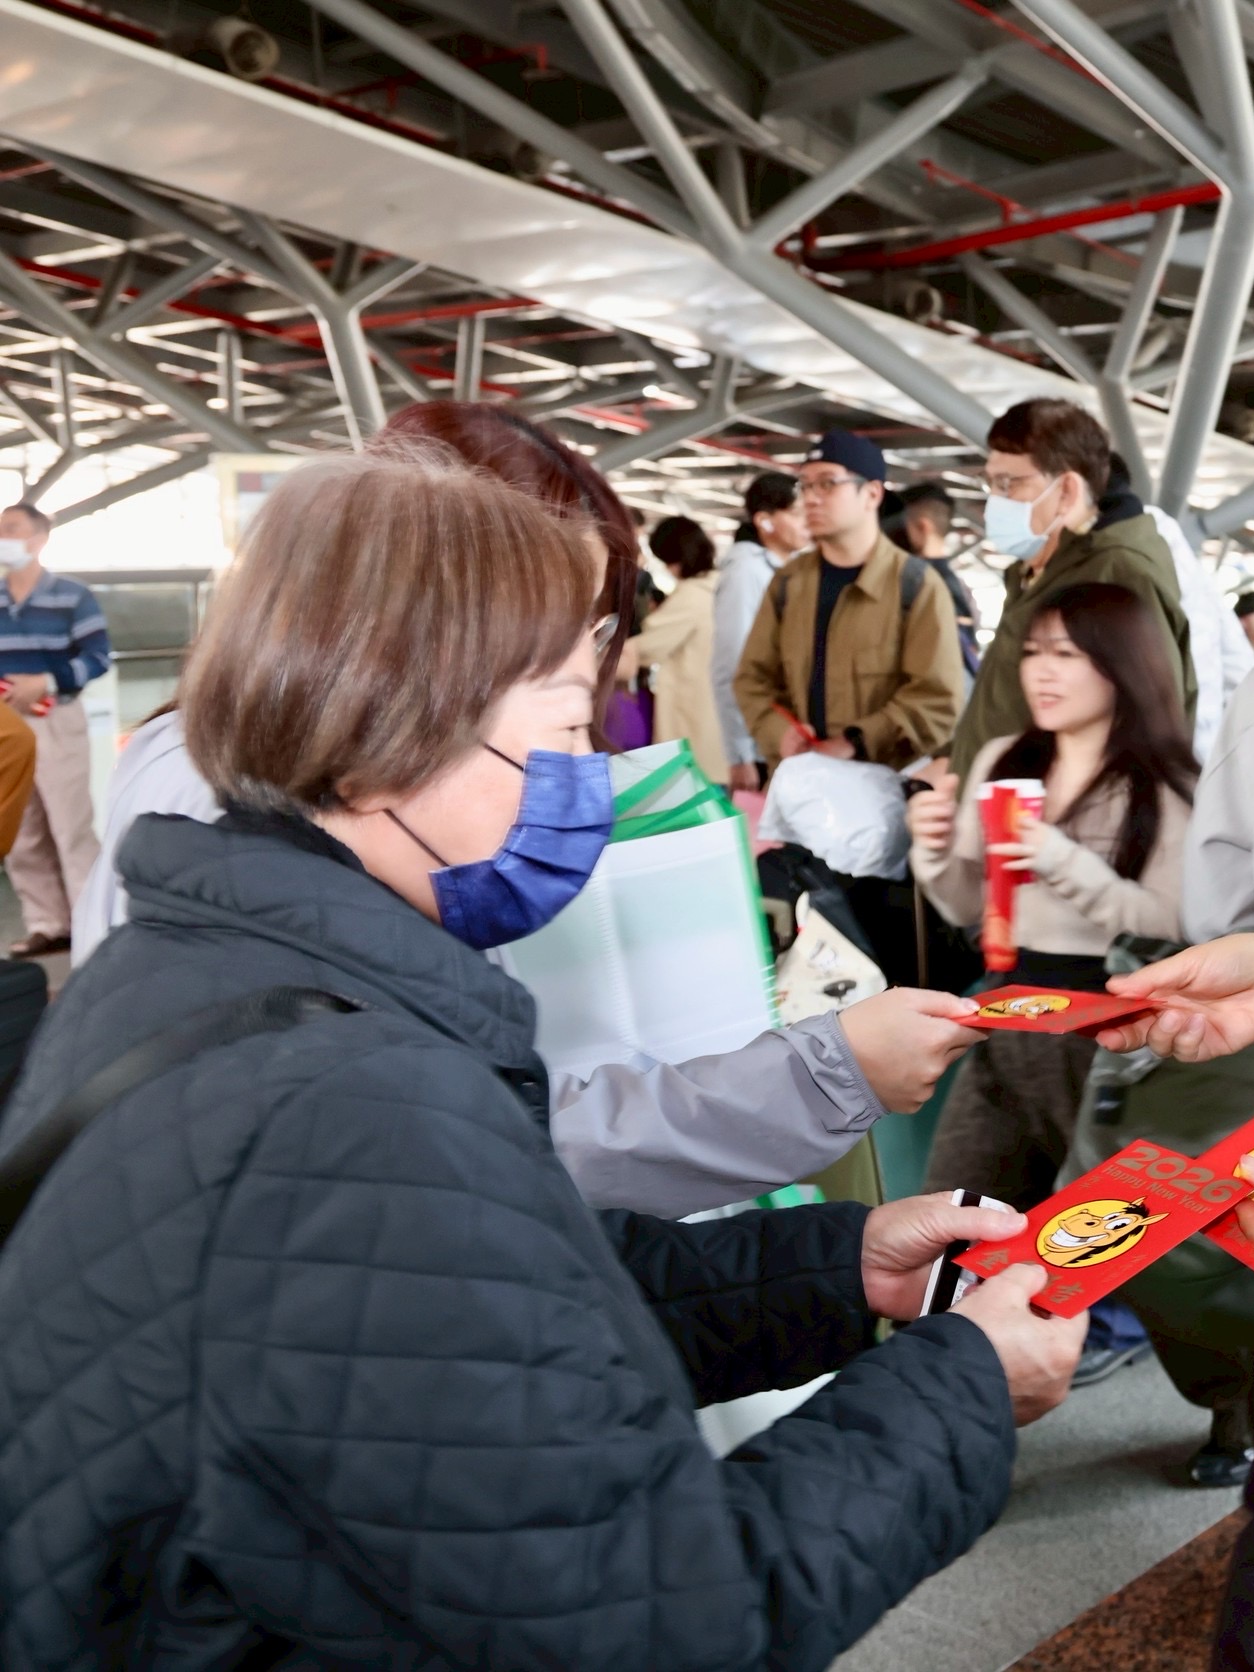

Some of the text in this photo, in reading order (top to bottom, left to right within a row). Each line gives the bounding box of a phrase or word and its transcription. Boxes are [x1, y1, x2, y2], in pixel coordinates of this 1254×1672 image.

[1102, 1164, 1211, 1214] Happy New Year
[1115, 1146, 1243, 1203] 2026
